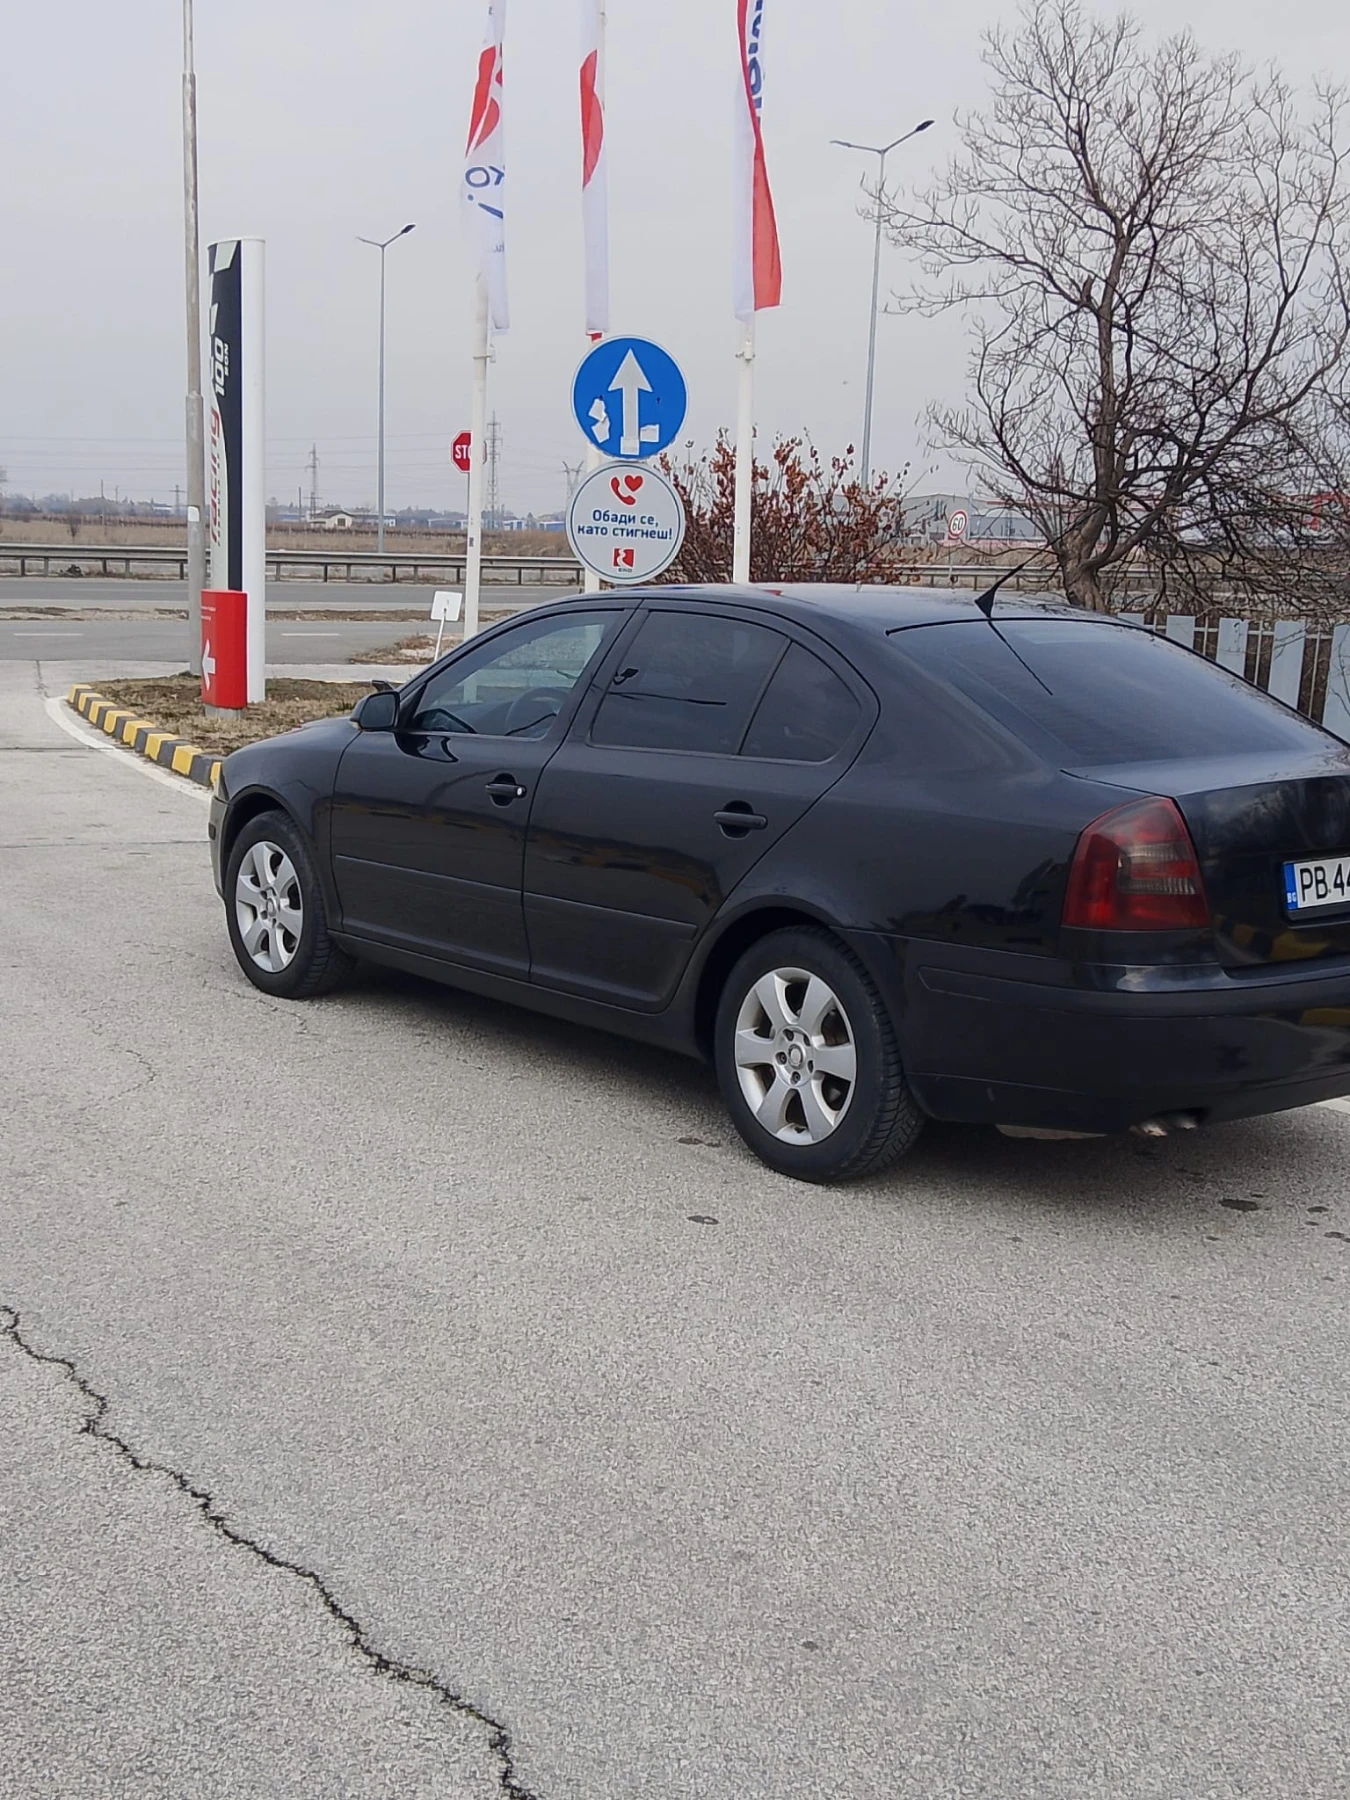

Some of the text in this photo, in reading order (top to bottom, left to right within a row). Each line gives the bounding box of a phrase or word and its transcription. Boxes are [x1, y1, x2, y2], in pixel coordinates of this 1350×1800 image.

[215, 336, 225, 397] 100
[593, 509, 659, 527] Обади се,
[952, 516, 963, 531] 60
[577, 525, 673, 540] като стигнеш!
